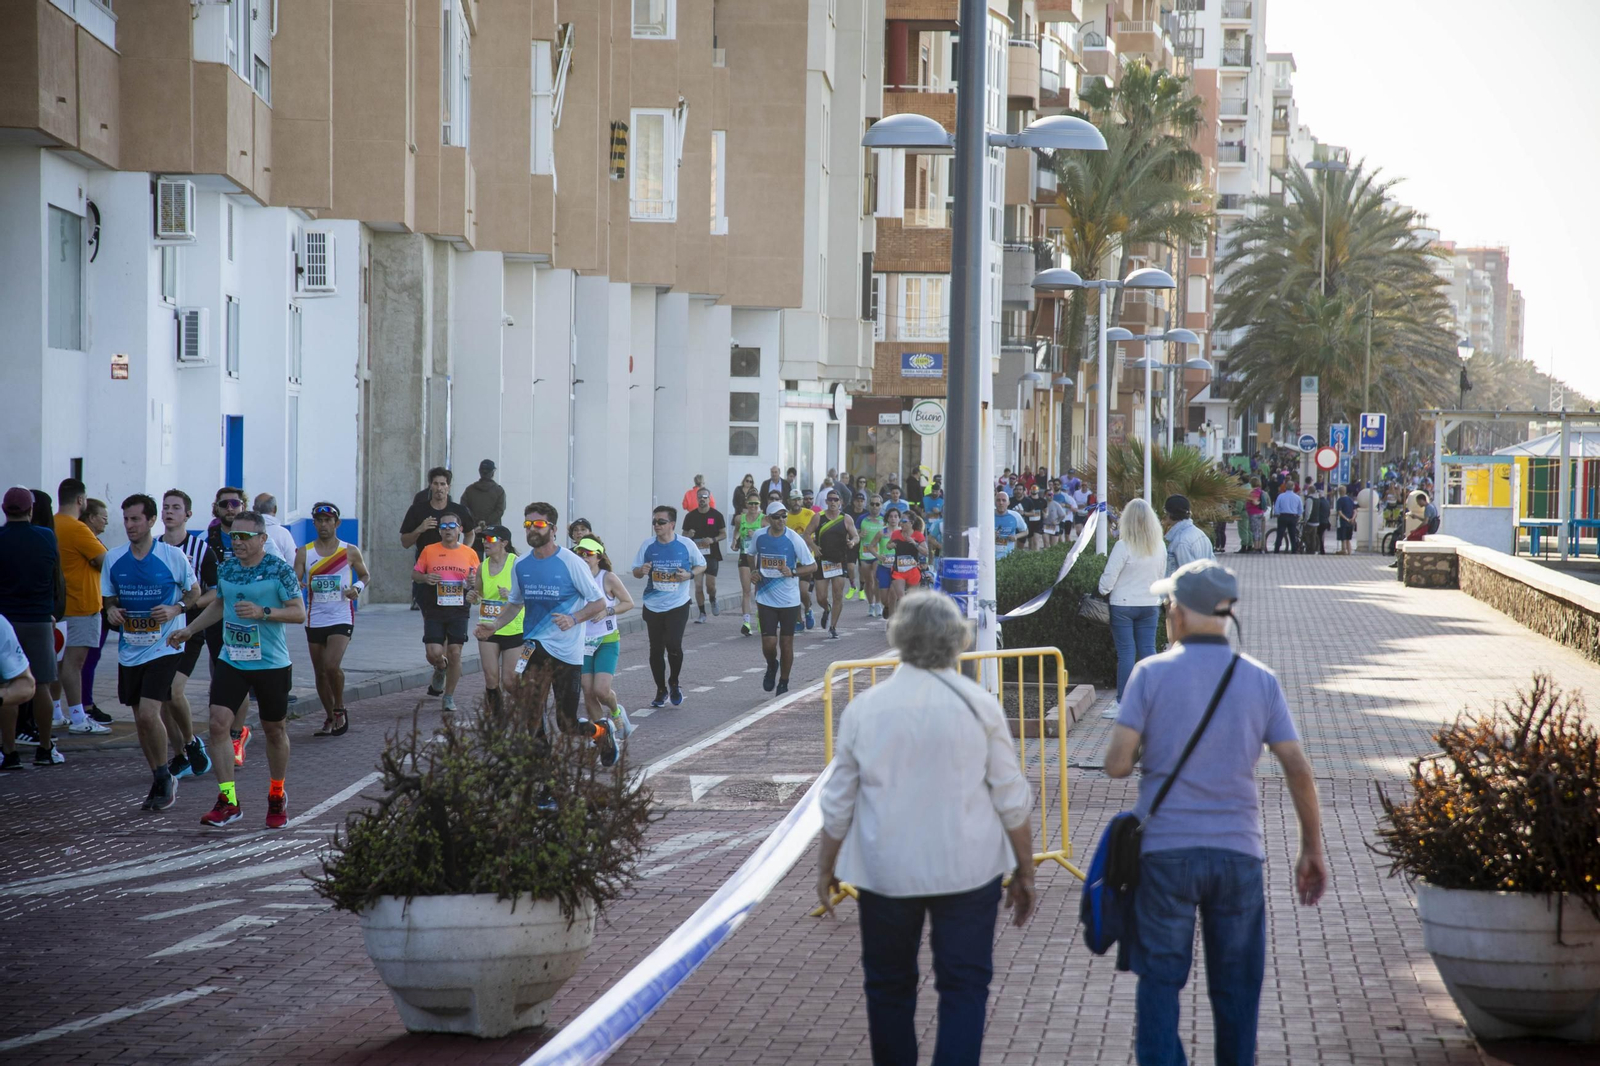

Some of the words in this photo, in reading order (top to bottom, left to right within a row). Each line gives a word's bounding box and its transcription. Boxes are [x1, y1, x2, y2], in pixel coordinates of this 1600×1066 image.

[915, 409, 942, 422] Buono
[432, 566, 466, 574] COSENTINO
[316, 580, 335, 589] 999
[126, 618, 156, 629] 1080
[230, 630, 251, 643] 760
